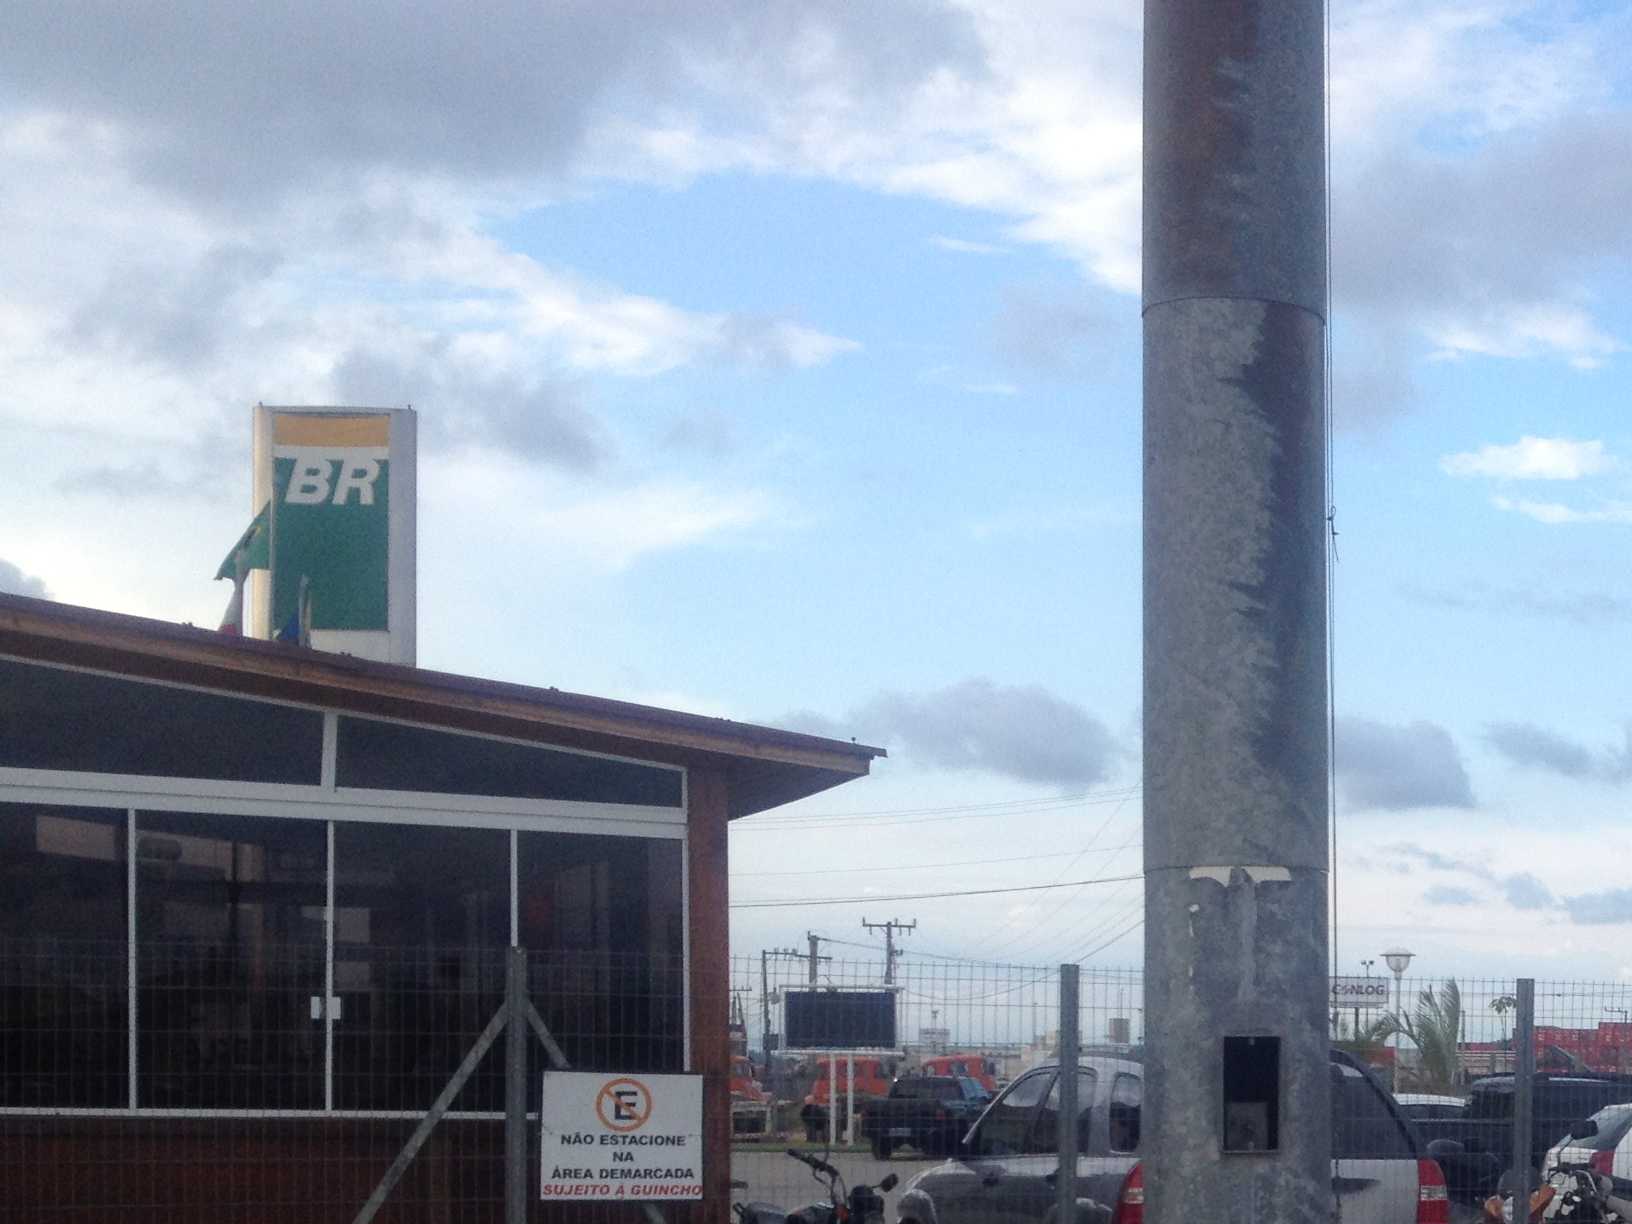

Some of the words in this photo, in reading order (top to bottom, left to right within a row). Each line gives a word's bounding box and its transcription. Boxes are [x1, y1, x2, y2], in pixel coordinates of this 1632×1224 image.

[285, 455, 380, 505] BR
[560, 1131, 595, 1147] NÃO
[599, 1134, 687, 1147] ESTACIONE
[612, 1151, 635, 1163] NA
[551, 1165, 594, 1180] ÁREA
[599, 1167, 695, 1180] DEMARCADA
[542, 1184, 610, 1196] SUJEITO
[630, 1184, 703, 1197] GUINCHO
